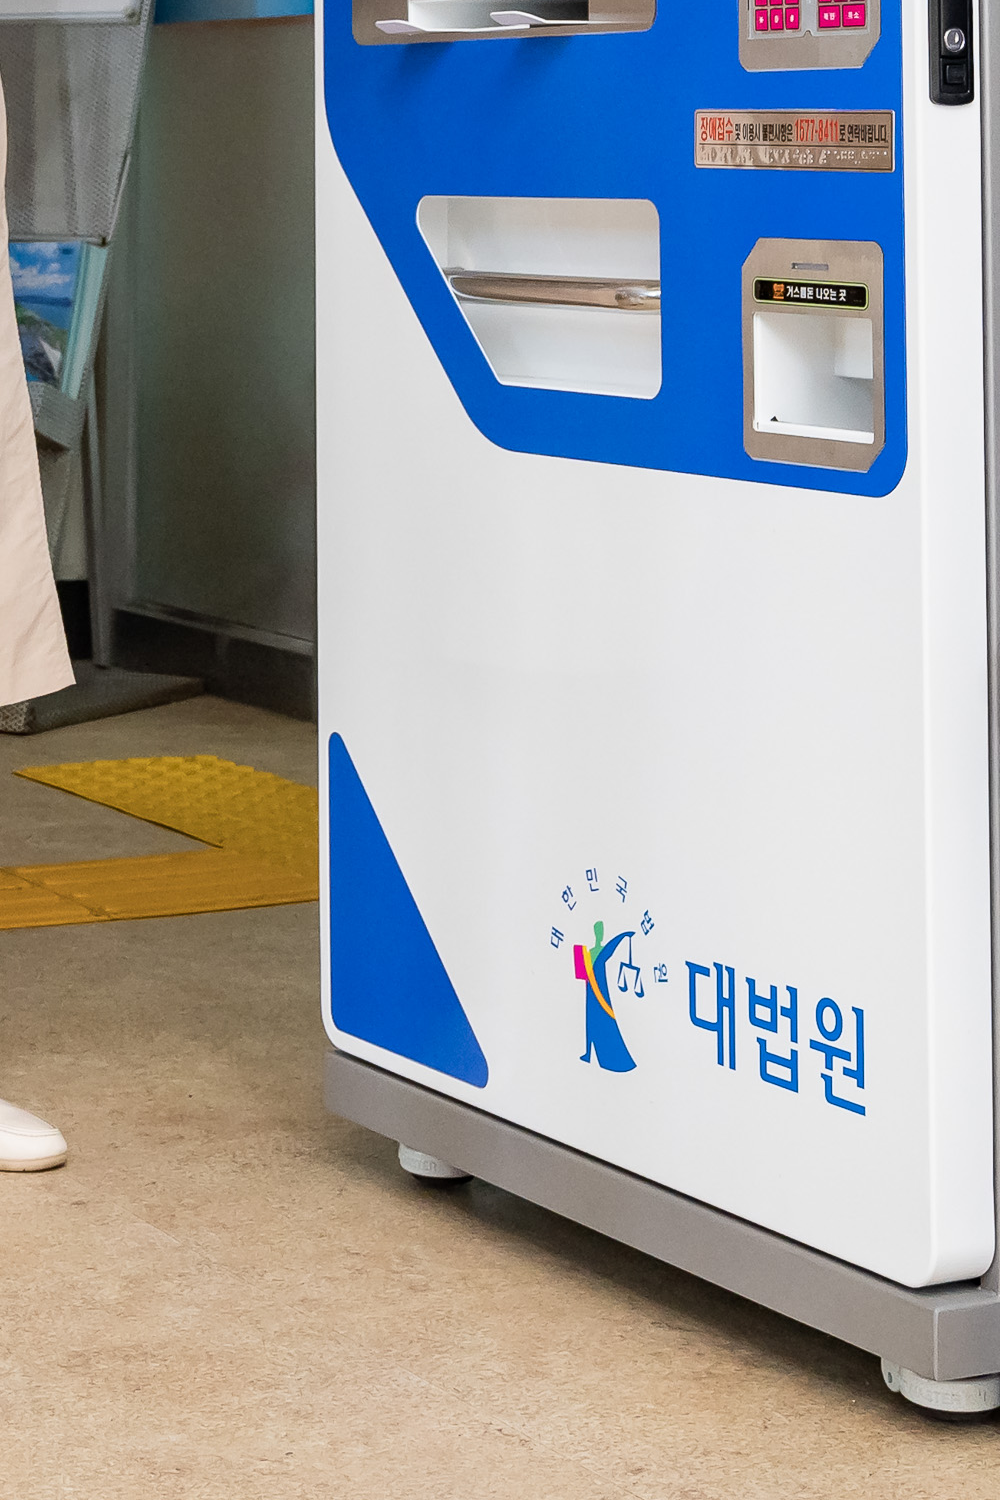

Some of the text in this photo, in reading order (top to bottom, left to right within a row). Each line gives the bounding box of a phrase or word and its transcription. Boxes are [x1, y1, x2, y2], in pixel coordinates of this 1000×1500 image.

[700, 117, 733, 141] 장애접수
[735, 124, 741, 140] 및
[743, 124, 761, 142] 이용시
[762, 124, 793, 143] 불편사항은
[786, 285, 846, 302] 거스름돈 나오는 곳
[685, 960, 866, 1117] 대법원
